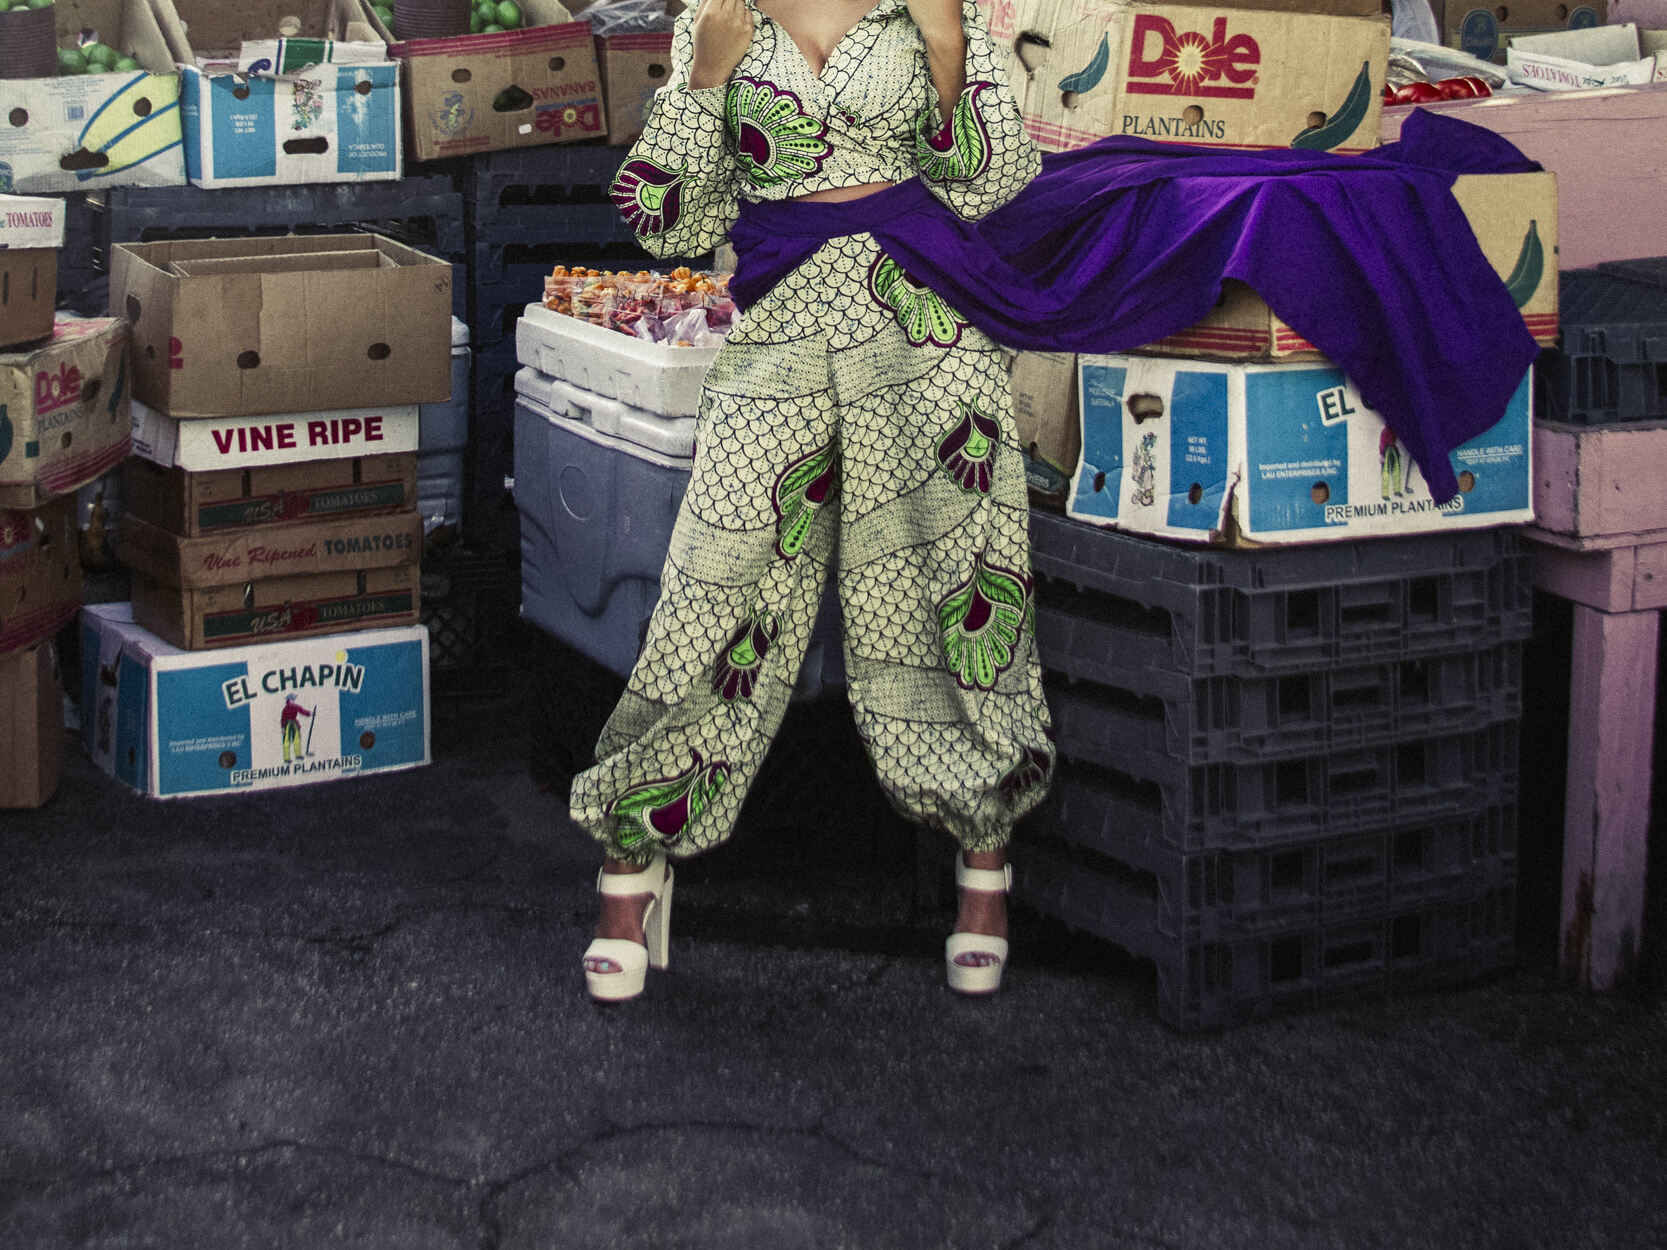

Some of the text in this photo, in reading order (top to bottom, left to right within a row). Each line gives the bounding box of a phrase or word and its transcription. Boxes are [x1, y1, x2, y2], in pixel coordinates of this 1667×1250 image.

[1127, 13, 1262, 85] Dole
[531, 80, 596, 101] BANANAS
[1521, 64, 1582, 89] TOMATOES
[534, 102, 601, 138] Dole
[1122, 115, 1226, 139] PLANTAINS
[5, 211, 53, 229] TOMATOES
[36, 361, 81, 407] Dole
[1320, 388, 1356, 421] EL
[211, 416, 384, 455] VINE RIPE
[243, 490, 379, 521] USA TOMATOES
[1326, 502, 1388, 520] PREMIUM
[203, 532, 413, 571] Vine Ripened TOMATOES
[250, 608, 293, 634] USA
[225, 664, 363, 706] EL CHAPIN
[232, 754, 362, 783] PREMIUM PLANTAINS
